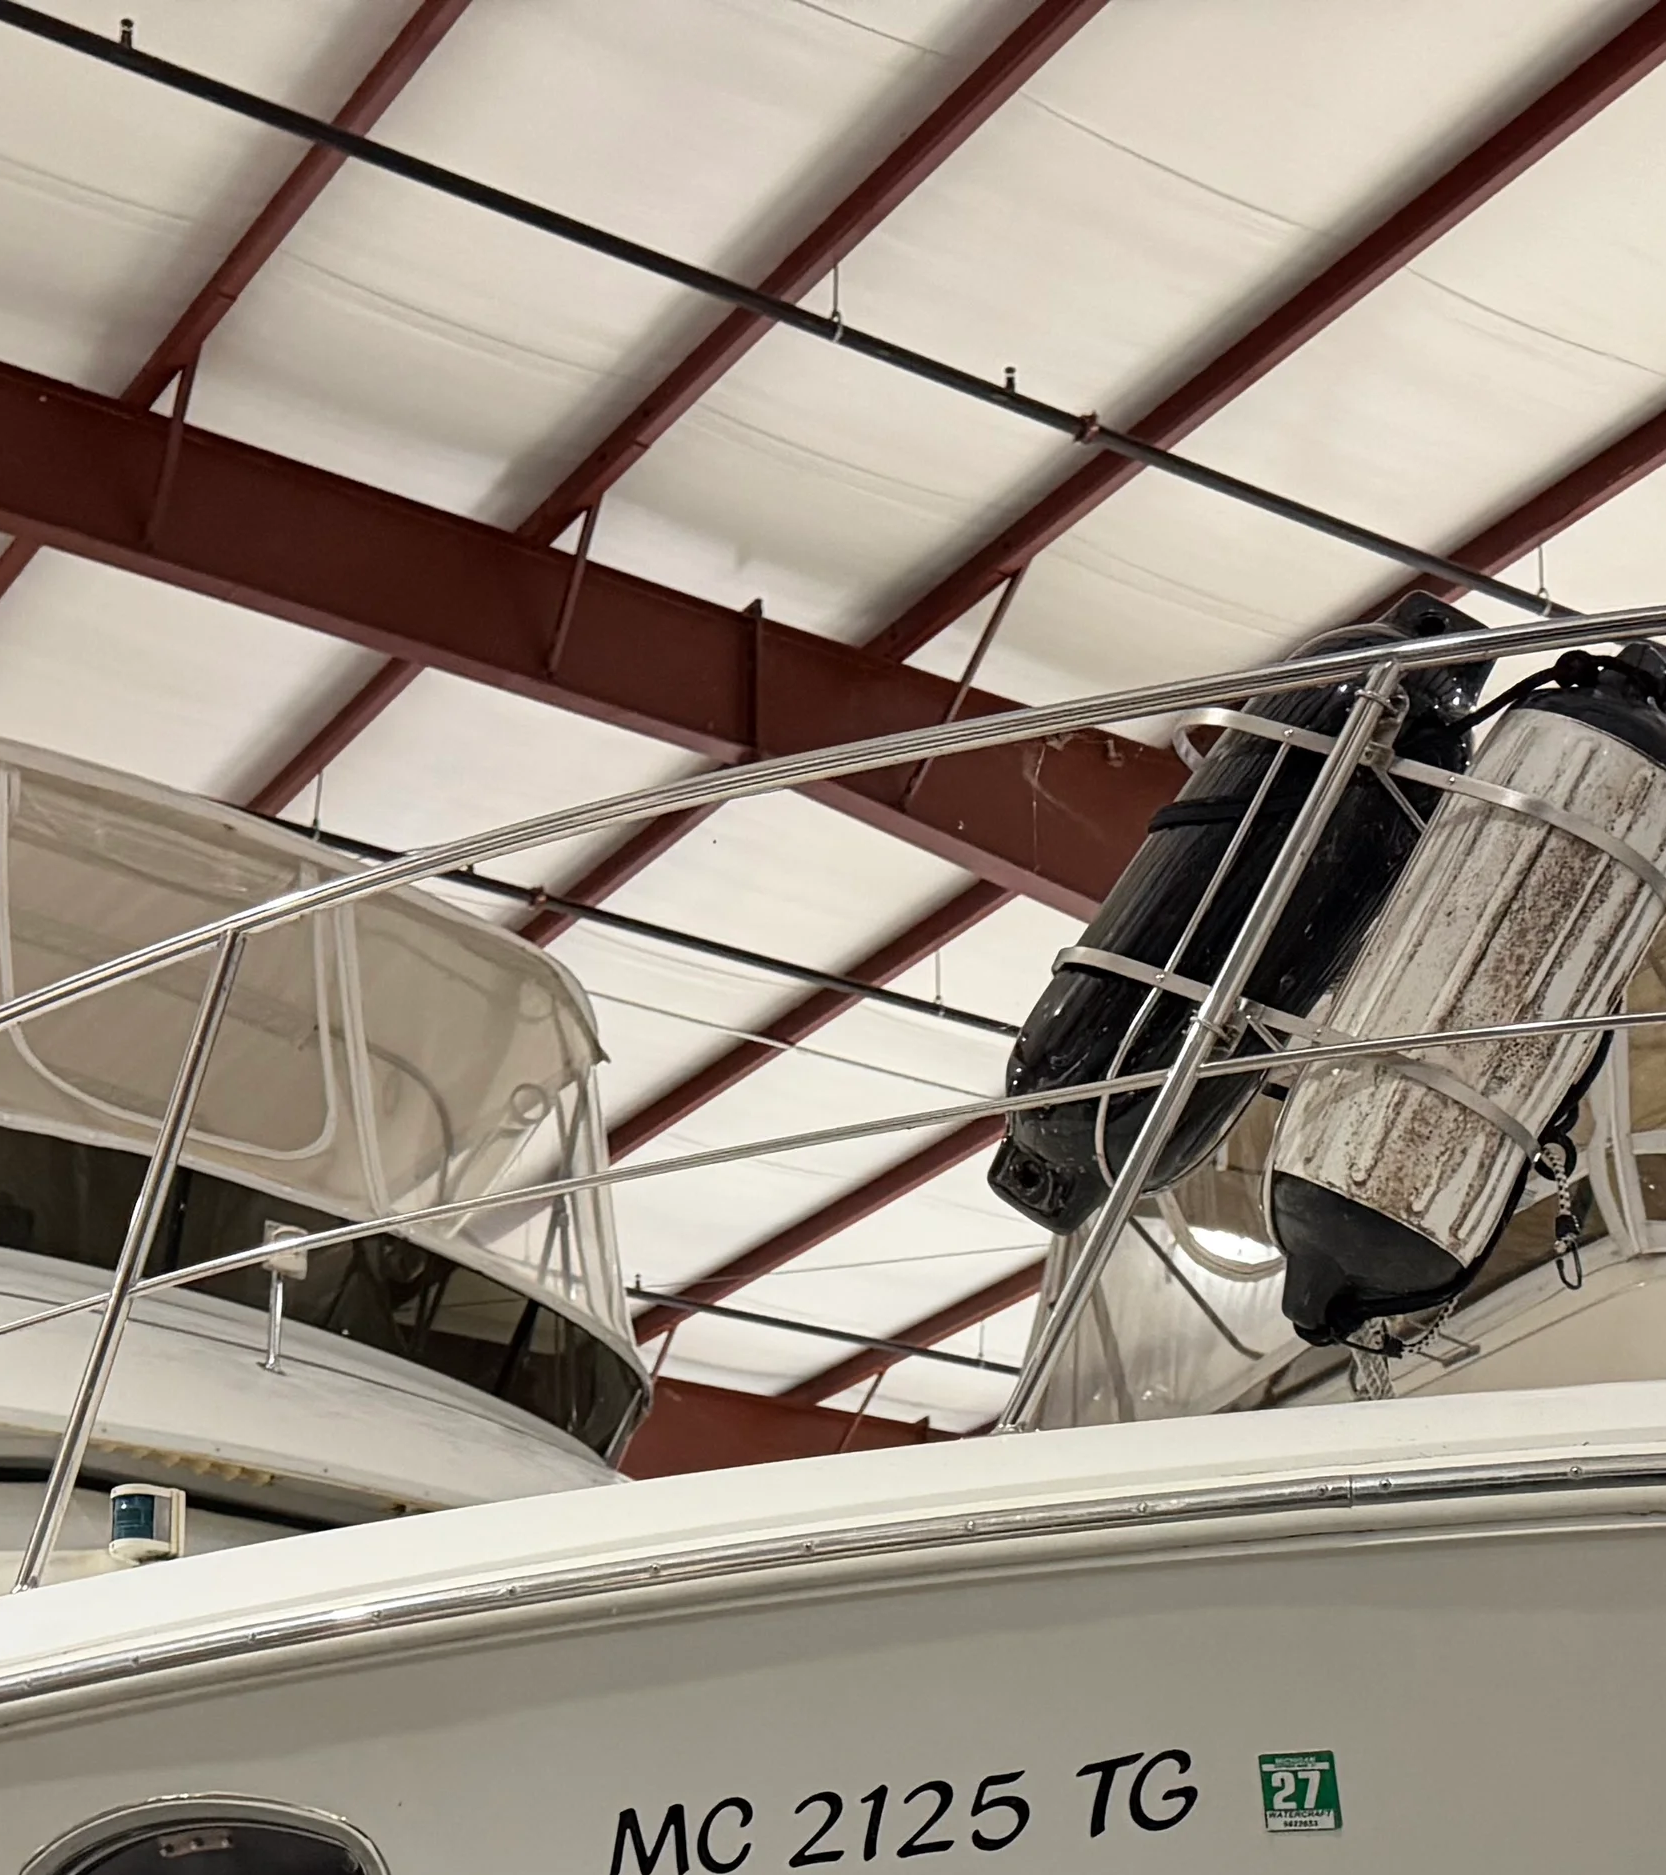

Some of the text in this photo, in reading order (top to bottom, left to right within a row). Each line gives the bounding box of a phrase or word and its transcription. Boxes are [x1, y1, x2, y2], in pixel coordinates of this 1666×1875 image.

[788, 1769, 1030, 1869] 2125
[1075, 1748, 1199, 1839] TG
[1271, 1769, 1321, 1810] 27
